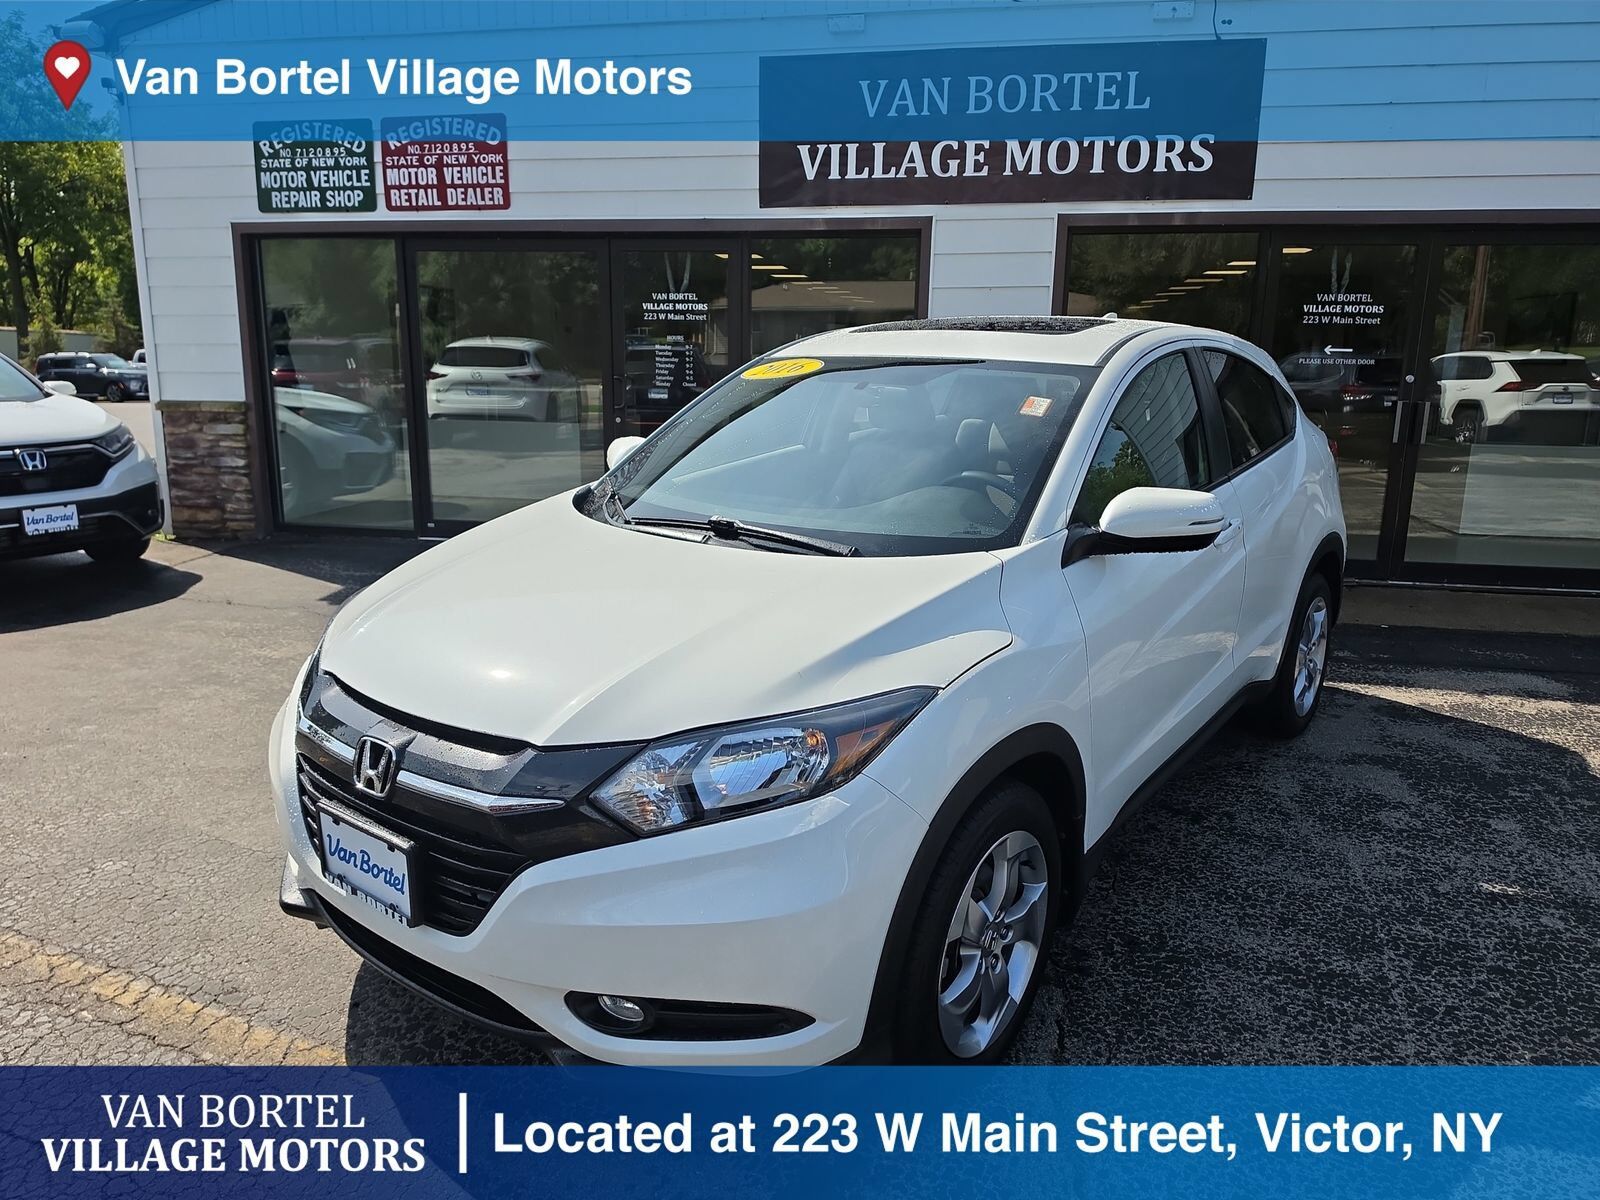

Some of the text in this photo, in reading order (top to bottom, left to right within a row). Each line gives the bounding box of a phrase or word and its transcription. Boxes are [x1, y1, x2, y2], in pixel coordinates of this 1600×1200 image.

[858, 71, 1150, 117] VAN BORTEL
[259, 122, 366, 156] REGISTERED
[385, 117, 502, 150] REGISTERED
[296, 147, 346, 157] 7120895
[423, 143, 475, 153] 7120895
[261, 156, 367, 168] STATE OF NEW YORK
[385, 154, 504, 166] STATE OF NEW YORK
[797, 133, 1216, 181] VILLAGE MOTORS
[260, 169, 371, 188] MOTOR VEHICLE
[386, 166, 505, 186] MOTOR VEHICLE
[271, 190, 364, 208] REPAIR SHOP
[390, 187, 504, 206] RETAIL DEALER
[1316, 293, 1373, 302] VAN BORTEL
[642, 302, 708, 311] VILLAGE MOTORS
[1303, 304, 1384, 314] VILLAGE MOTORS
[685, 313, 707, 321] Street
[1302, 316, 1381, 325] 223 W Main Street
[26, 511, 74, 526] Van Bortel
[326, 833, 406, 896] Van Bortel
